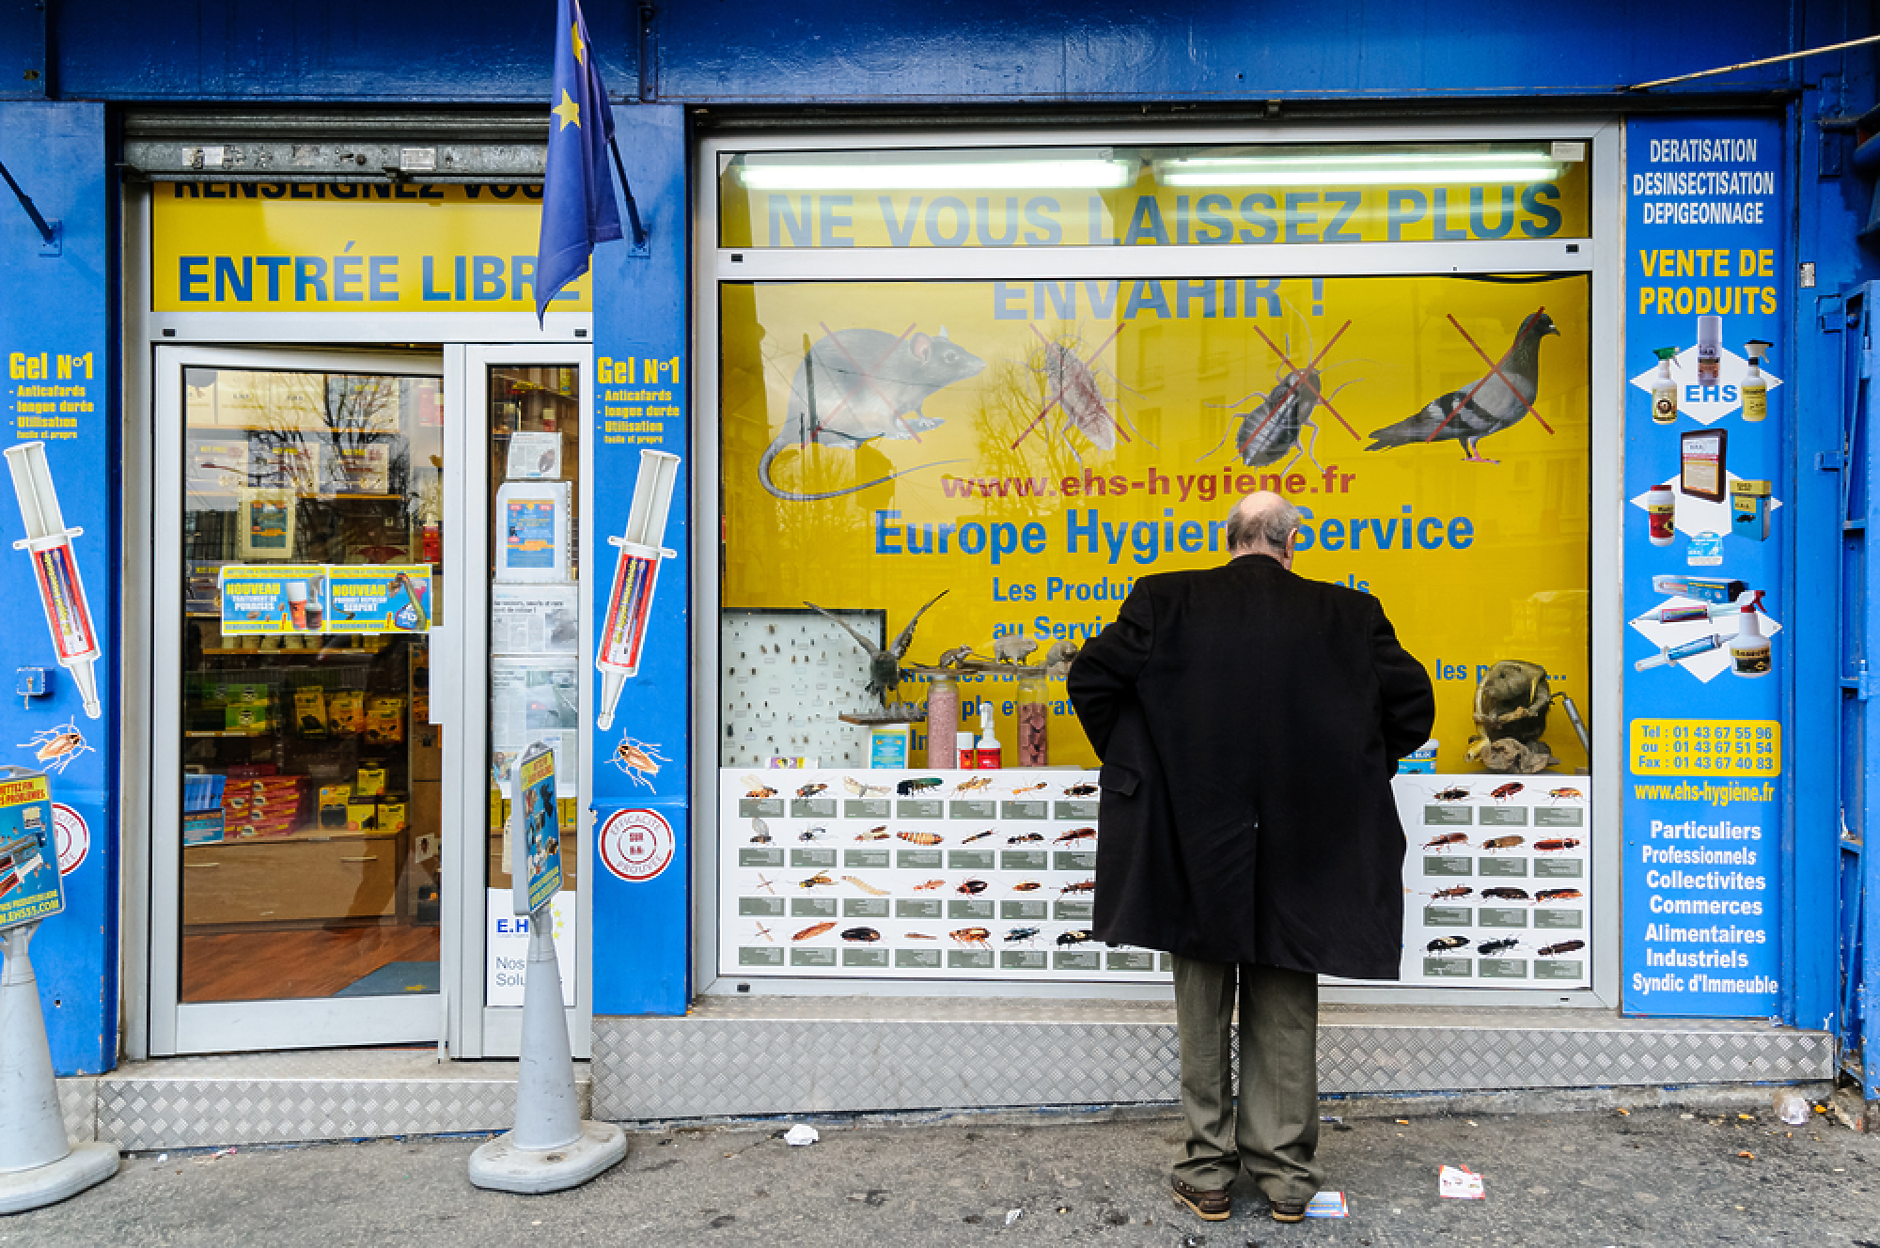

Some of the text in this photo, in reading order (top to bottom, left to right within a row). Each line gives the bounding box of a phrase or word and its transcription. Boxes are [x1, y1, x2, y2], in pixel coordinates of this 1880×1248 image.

[1650, 138, 1757, 162] DERATISATION
[1633, 170, 1774, 196] DESINSECTISATION
[768, 183, 1562, 246] NE VOUS LAISSEZ PLUS
[1643, 202, 1764, 224] DEPIGEONNAGE
[179, 241, 579, 302] ENTRÉE LIBR
[1639, 249, 1774, 277] VENTE DE
[994, 279, 1283, 320] ENVAHIR
[1639, 286, 1777, 314] PRODUITS
[10, 352, 48, 379] Gel
[597, 356, 634, 384] Gel
[17, 385, 86, 397] Anticafards
[605, 389, 672, 401] Anticafards
[1685, 384, 1738, 403] EHS
[17, 400, 56, 414] longue
[605, 405, 643, 419] longue
[941, 466, 1356, 501] www.ehs-hygiene.fr
[875, 508, 1047, 565] Europe
[1066, 508, 1228, 564] Hygien
[993, 576, 1134, 601] Les Produi
[993, 615, 1113, 641] au Servi
[1435, 659, 1468, 680] les
[1640, 725, 1660, 738] Tel
[1673, 726, 1689, 739] 01
[1693, 727, 1711, 739] 43
[1714, 727, 1731, 739] 67
[1735, 727, 1752, 739] 55
[1640, 742, 1659, 753] ou
[1673, 741, 1689, 753] 01
[1693, 741, 1711, 754] 43
[1714, 742, 1731, 754] 67
[1735, 742, 1751, 754] 51
[1755, 742, 1773, 754] 54
[1639, 755, 1661, 769] Fax
[1673, 756, 1689, 769] 01
[1693, 757, 1711, 769] 43
[1714, 757, 1731, 769] 67
[1735, 757, 1753, 769] 40
[1650, 820, 1762, 840] Particuliers
[1642, 845, 1757, 865] Professionnels
[1646, 870, 1766, 890] Collectivites
[1650, 894, 1763, 915] Commerces
[1645, 922, 1766, 944] Alimentaires
[496, 956, 526, 970] Nos
[1646, 948, 1749, 968] Industriels
[1633, 972, 1779, 996] Syndic d'Immeuble
